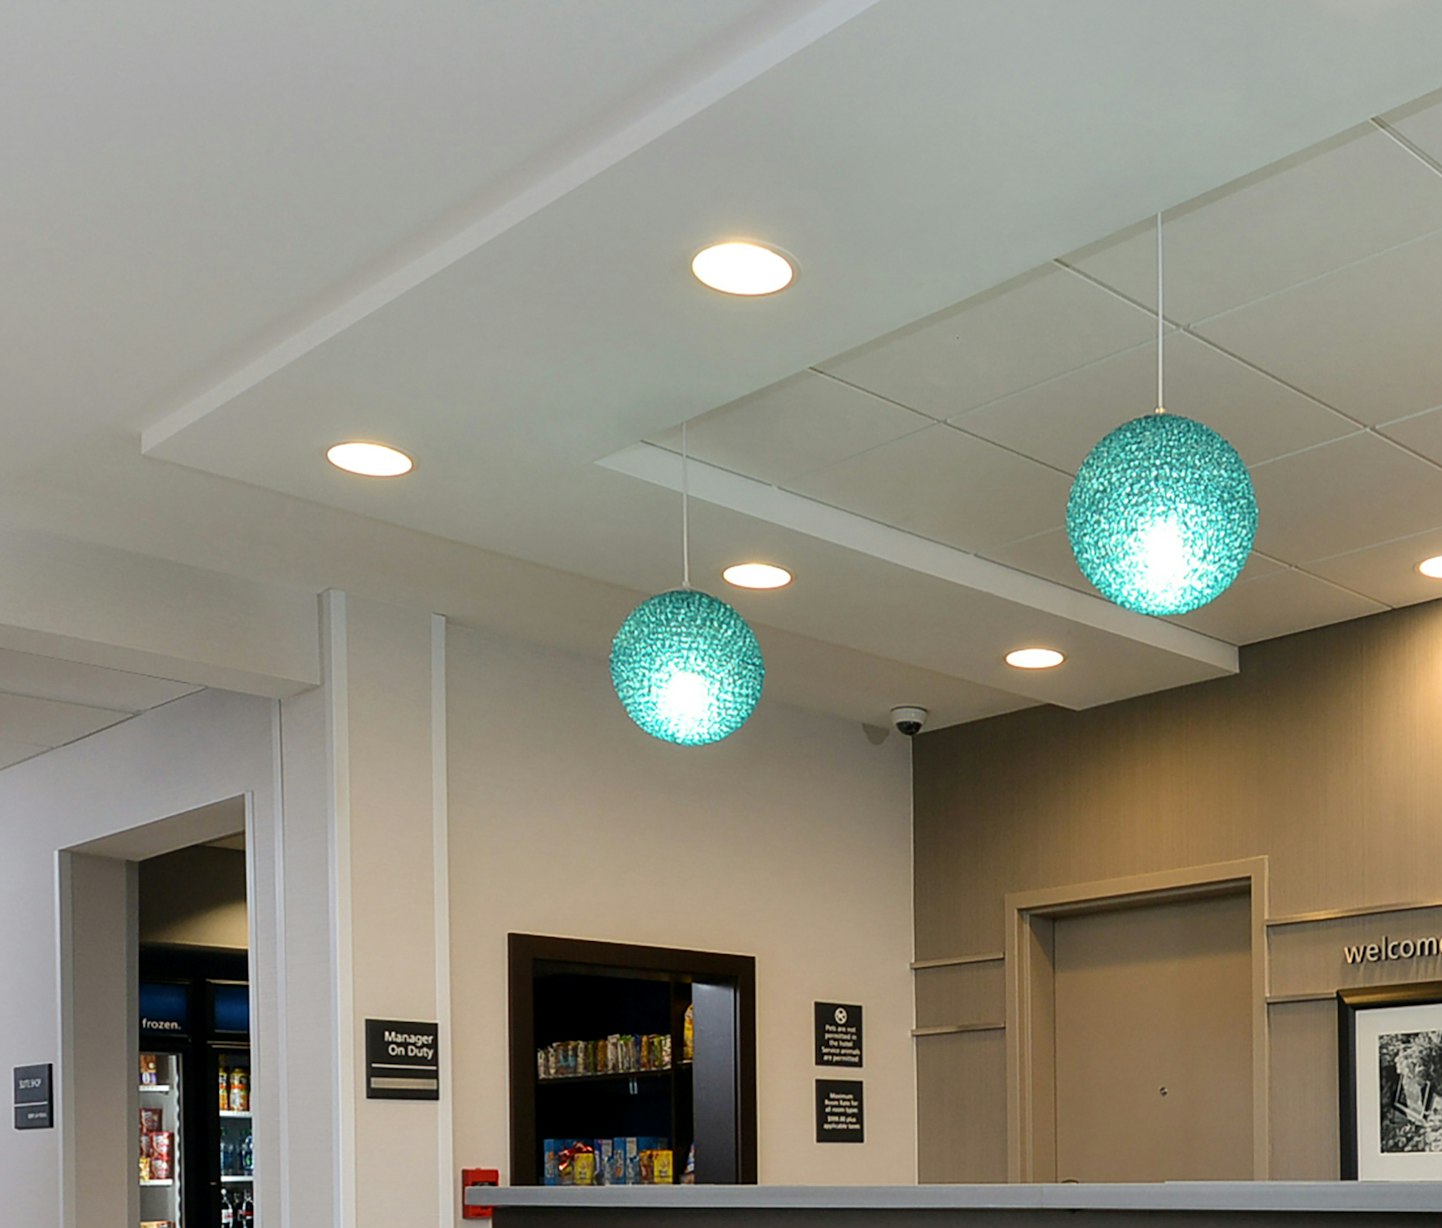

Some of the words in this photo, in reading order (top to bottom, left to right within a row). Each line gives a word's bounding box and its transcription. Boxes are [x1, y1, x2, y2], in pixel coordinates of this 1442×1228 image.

[141, 1017, 182, 1031] frozen.
[384, 1030, 434, 1047] Manager
[388, 1044, 406, 1056] On
[407, 1045, 434, 1060] Duty
